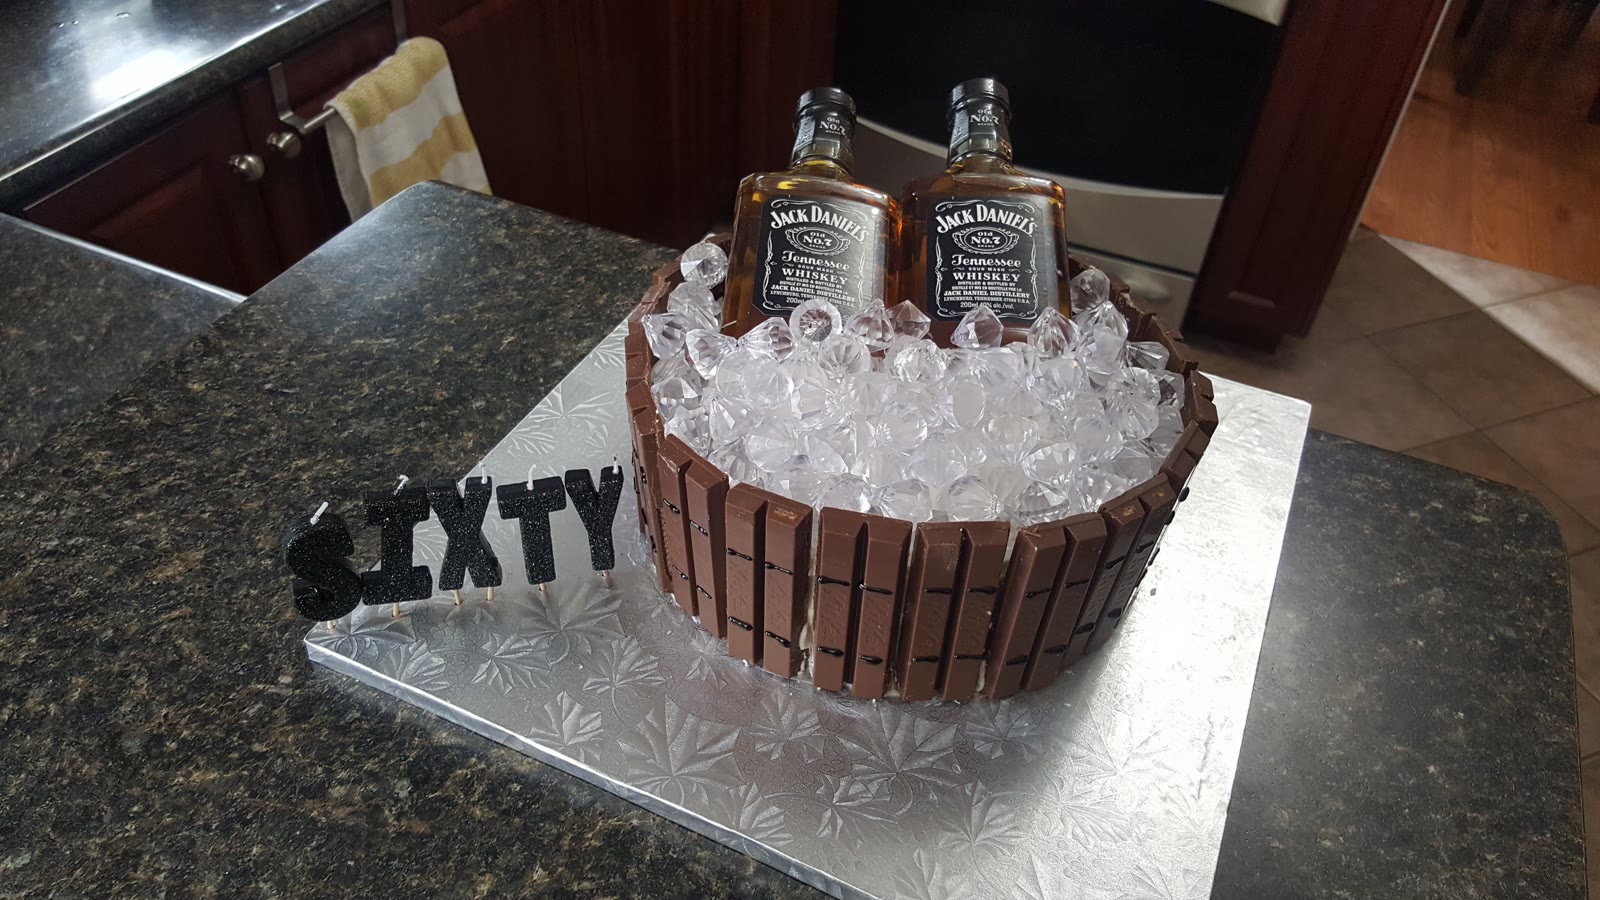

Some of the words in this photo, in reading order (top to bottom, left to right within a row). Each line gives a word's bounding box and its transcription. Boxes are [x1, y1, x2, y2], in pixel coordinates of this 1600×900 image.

[970, 114, 1000, 125] No.7
[819, 121, 846, 136] No.7
[770, 209, 810, 229] JACK
[811, 205, 870, 242] DANIEL'S
[936, 209, 976, 234] JACK
[976, 204, 1038, 238] DANIEL'S
[802, 235, 833, 247] No.7
[970, 236, 1001, 245] No.7
[781, 250, 850, 272] Tennessee
[951, 254, 1021, 267] Tennessee
[782, 267, 849, 285] WHISKEY
[952, 272, 1020, 282] WHISKEY
[815, 280, 836, 288] BOTTLED
[790, 286, 815, 294] DANIEL
[816, 289, 855, 303] DISTILLERY
[989, 291, 1031, 299] DISTILLERY
[283, 465, 624, 622] SIXTY
